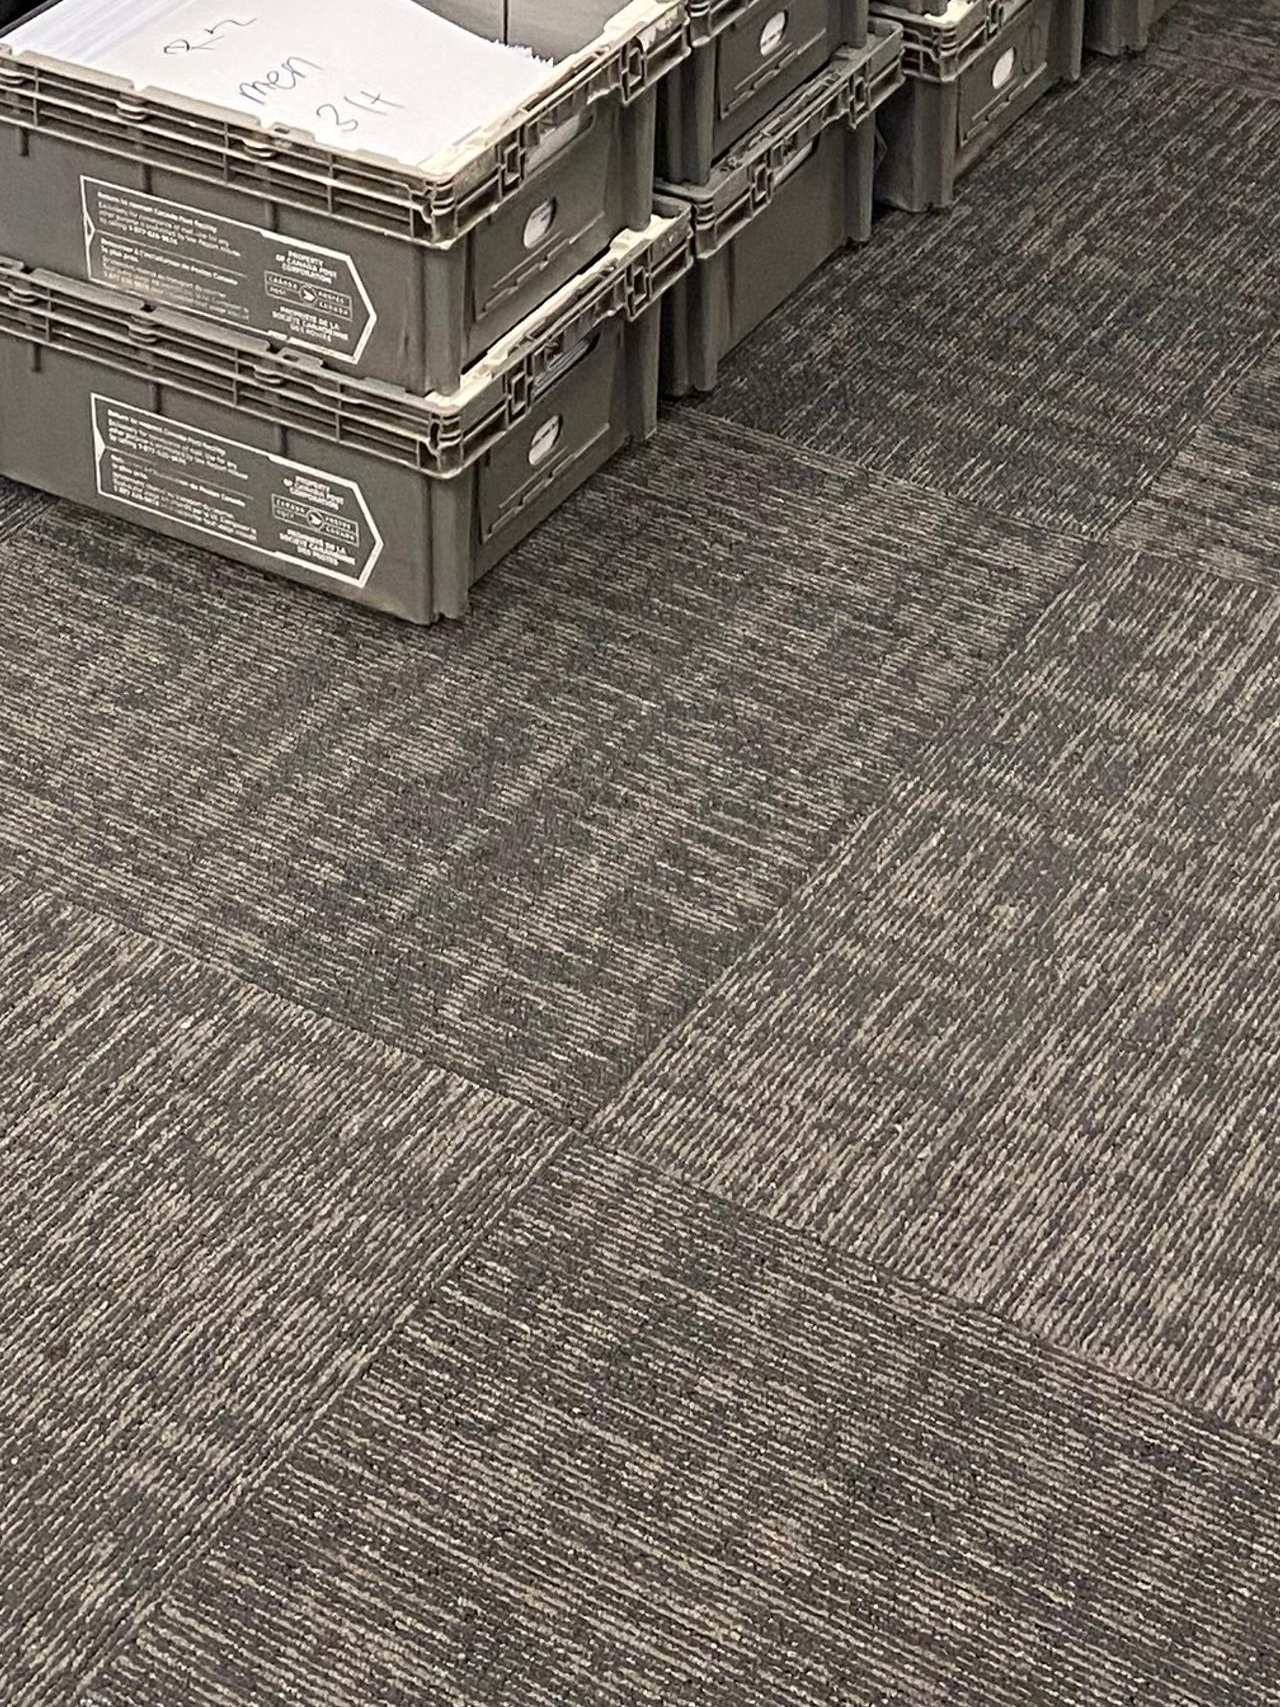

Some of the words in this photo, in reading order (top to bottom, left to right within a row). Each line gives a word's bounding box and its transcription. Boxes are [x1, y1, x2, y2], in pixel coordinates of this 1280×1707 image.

[286, 256, 317, 272] CANADA
[319, 266, 337, 278] POST
[288, 250, 323, 266] PROPERTY
[282, 262, 332, 284] CORPORATION
